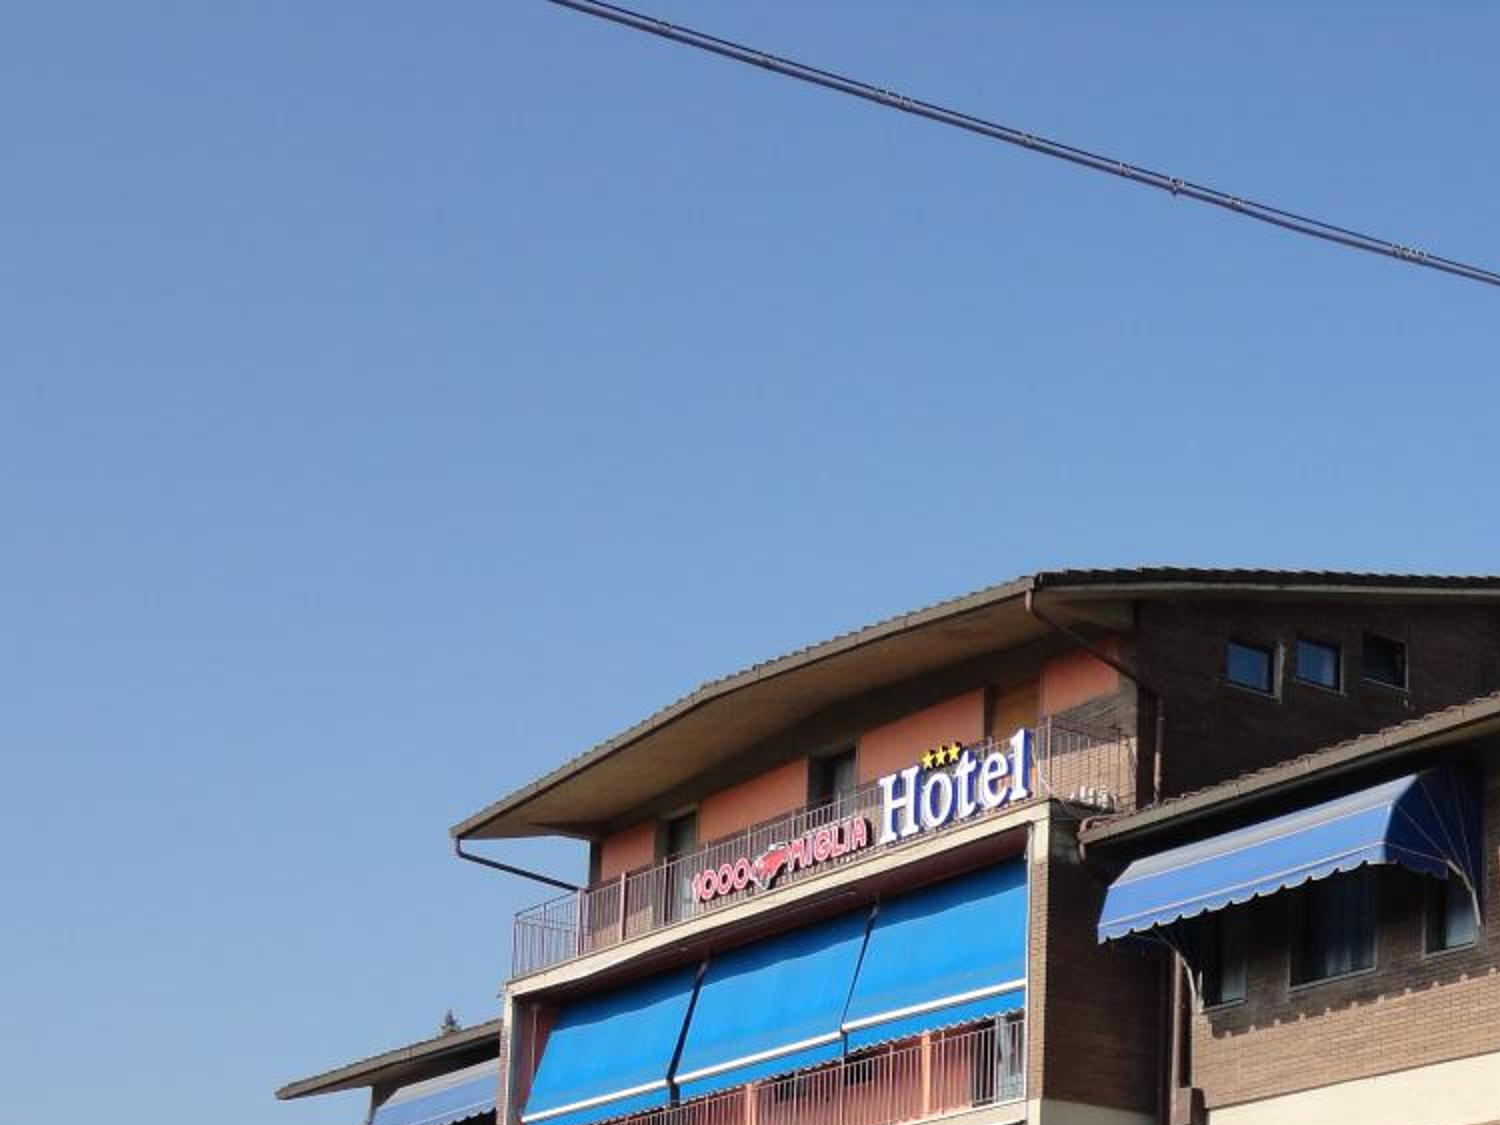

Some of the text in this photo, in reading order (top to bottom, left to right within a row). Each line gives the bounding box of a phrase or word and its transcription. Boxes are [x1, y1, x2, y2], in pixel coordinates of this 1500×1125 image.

[878, 728, 1034, 846] Hotel
[692, 816, 868, 902] 1000 MIGLIA
